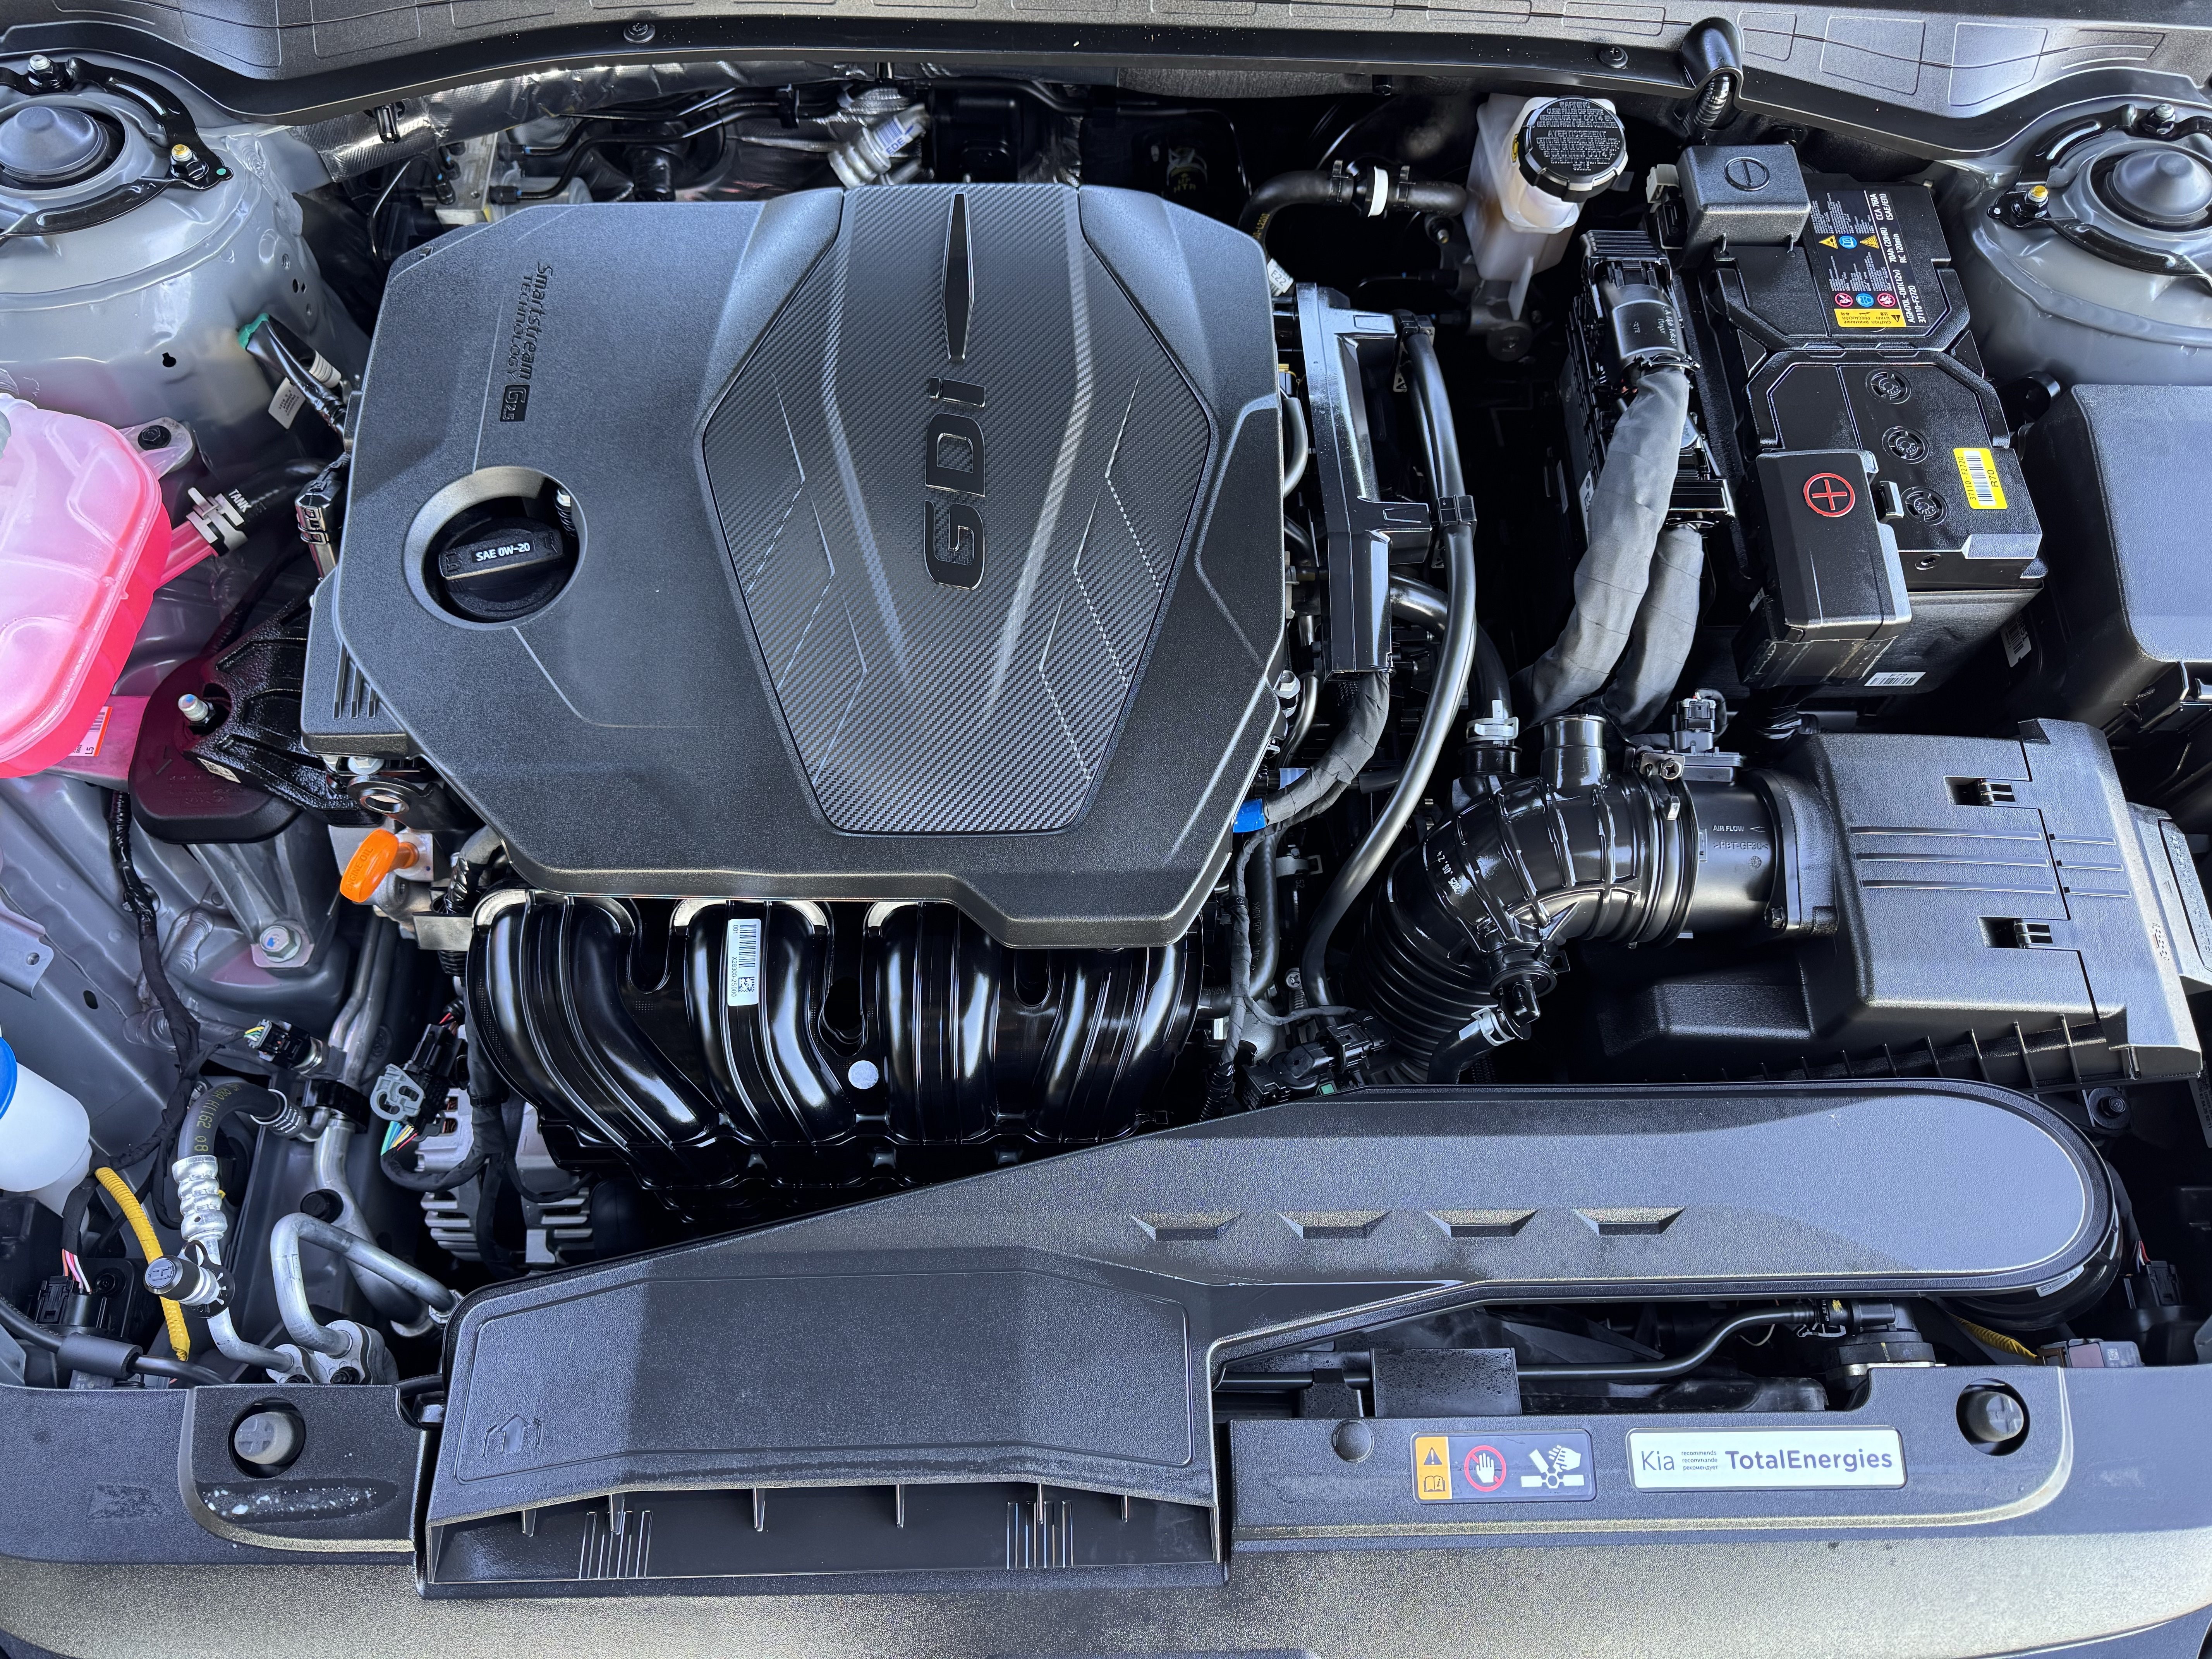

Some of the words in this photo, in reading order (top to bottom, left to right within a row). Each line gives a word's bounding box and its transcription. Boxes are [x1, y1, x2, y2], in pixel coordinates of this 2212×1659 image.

[886, 138, 905, 154] EDE
[1870, 194, 1880, 208] 760A
[1874, 208, 1884, 220] CCA
[1879, 227, 1892, 247] (20HR)
[1893, 234, 1904, 254] 120min
[1887, 248, 1897, 263] 70Ah
[1898, 254, 1907, 263] RC
[1271, 270, 1286, 286] E22
[506, 275, 533, 380] TECHNOLOGY
[519, 261, 553, 381] Smartstream
[1987, 470, 1999, 487] R70
[228, 488, 252, 513] TANK
[476, 549, 497, 561] SAE
[498, 543, 530, 556] 0W-20
[346, 862, 363, 891] ENGINE
[360, 848, 373, 862] OIL
[1641, 1450, 1675, 1471] Kia
[1725, 1449, 1893, 1472] TotalEnergies
